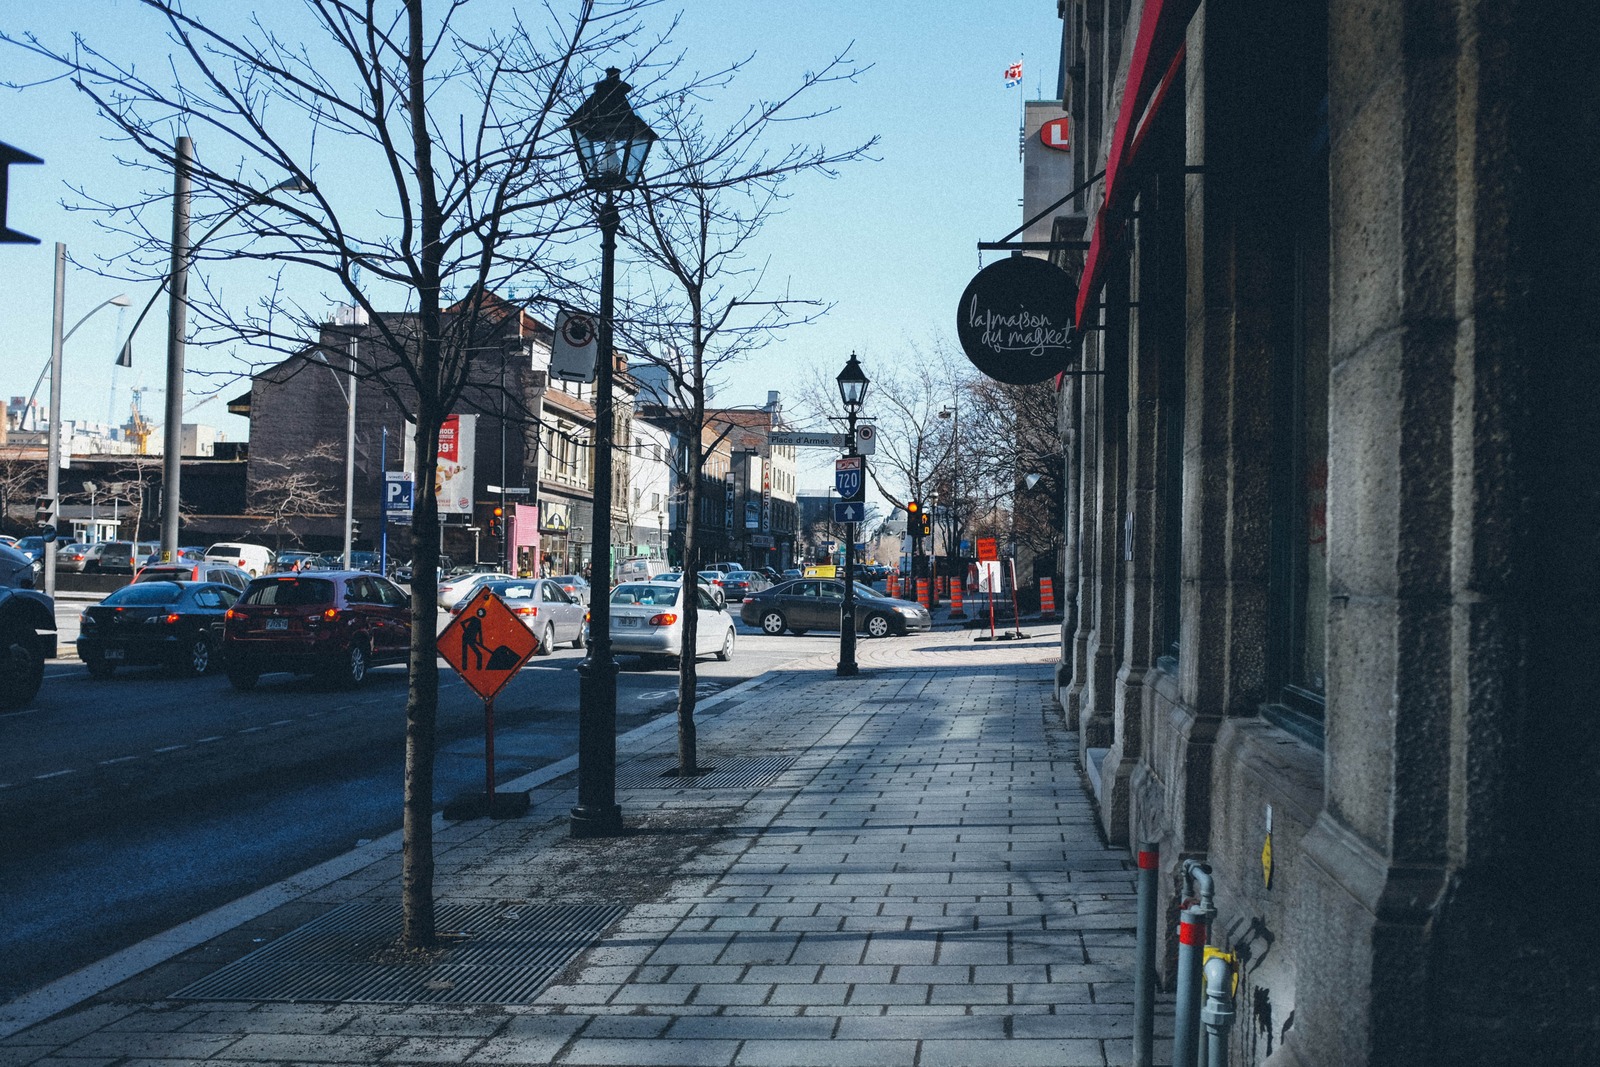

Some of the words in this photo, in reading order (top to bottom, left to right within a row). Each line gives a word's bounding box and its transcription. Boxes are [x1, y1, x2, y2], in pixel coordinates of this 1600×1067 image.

[969, 294, 986, 328] la
[991, 304, 1052, 330] maison
[981, 308, 1003, 354] du
[771, 436, 793, 444] Place
[796, 437, 829, 445] d'Armes
[838, 473, 858, 489] 720
[387, 483, 402, 502] P
